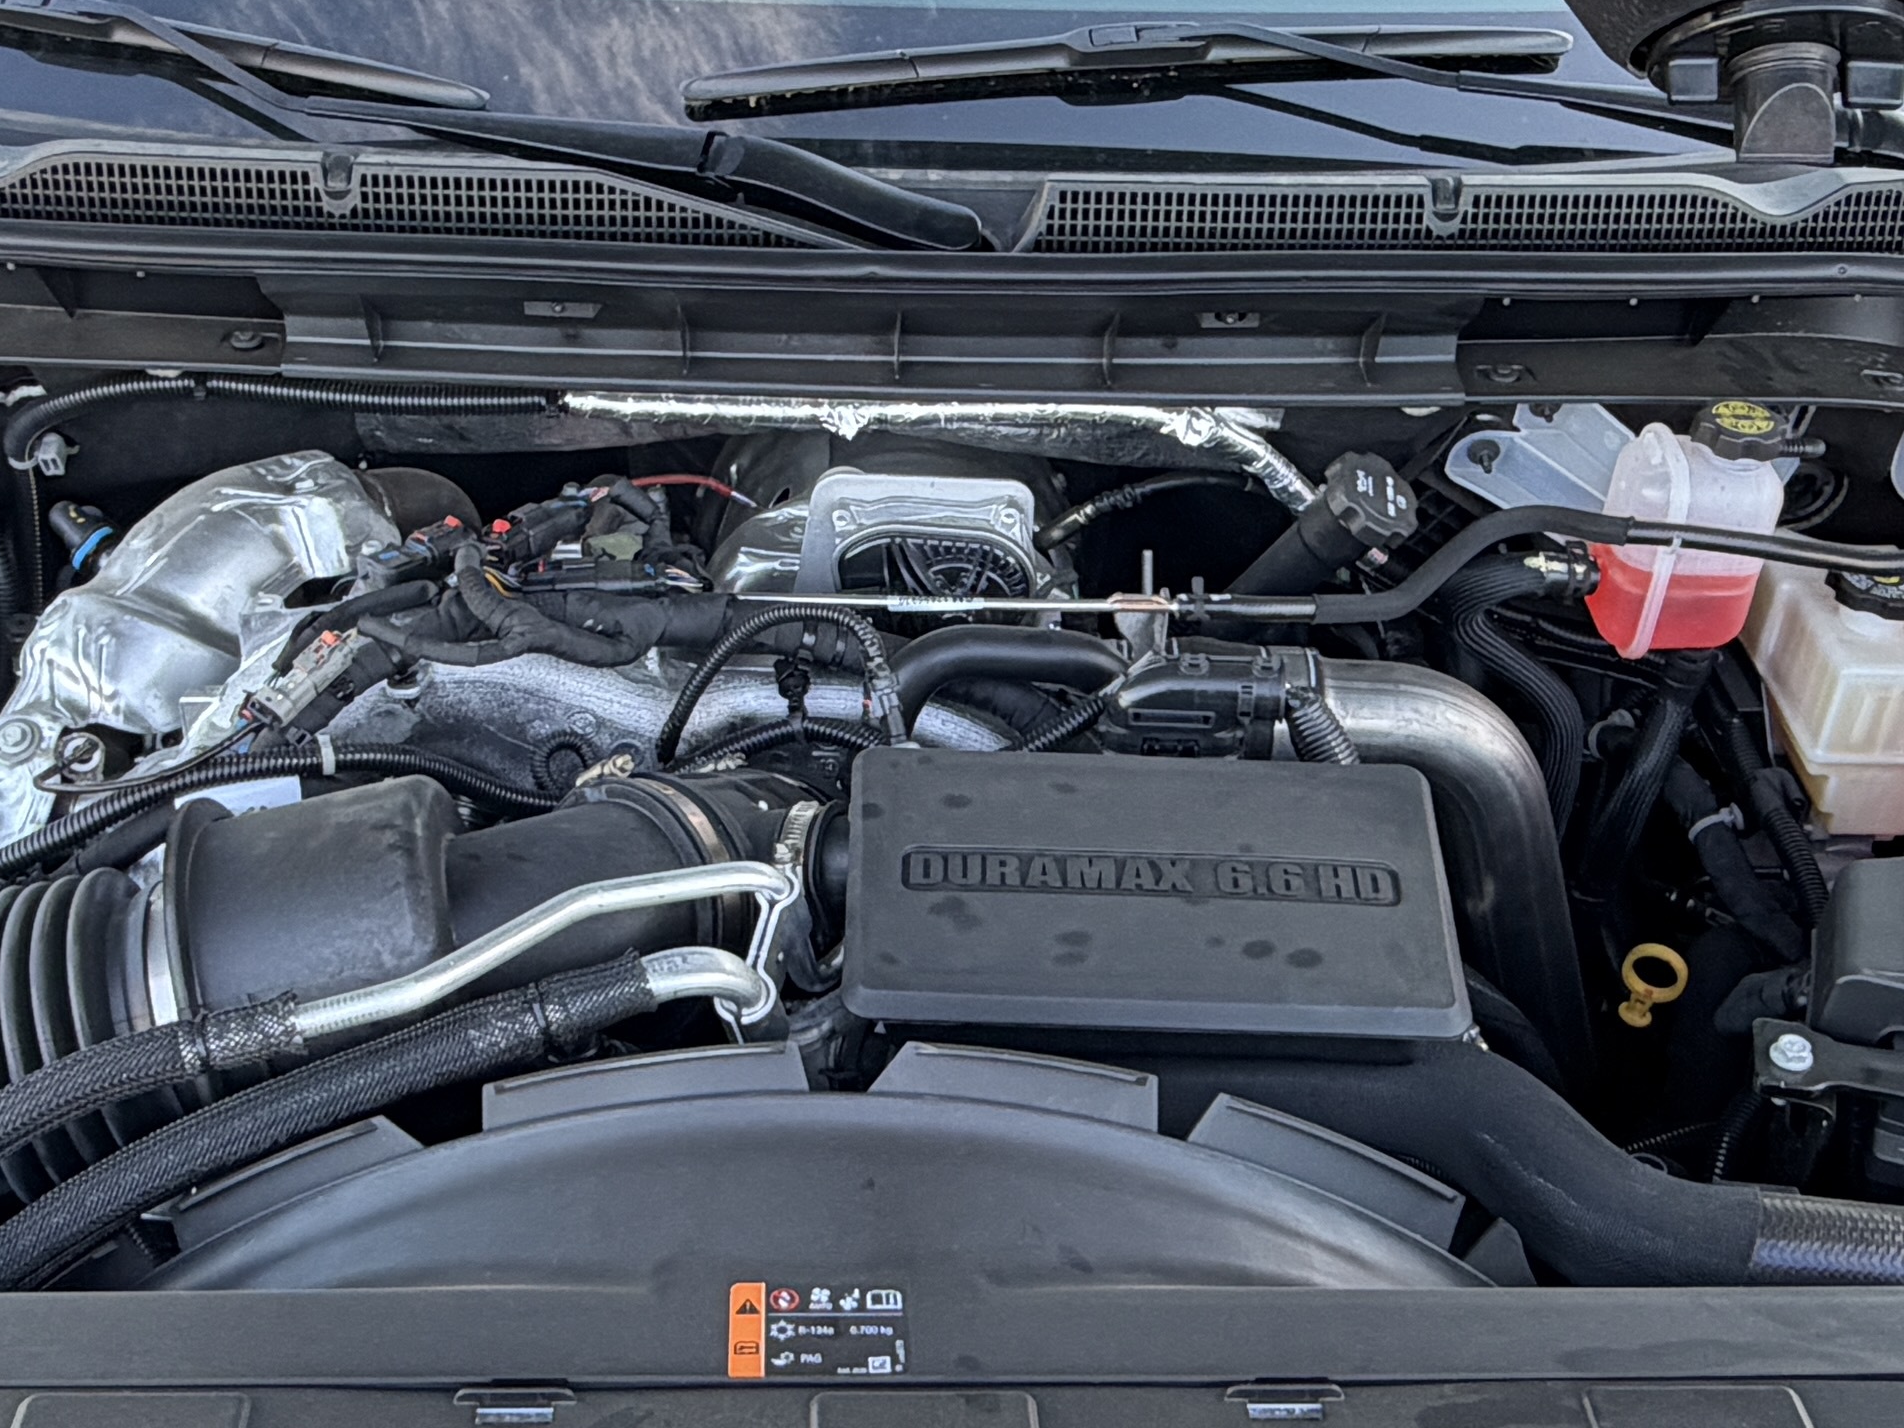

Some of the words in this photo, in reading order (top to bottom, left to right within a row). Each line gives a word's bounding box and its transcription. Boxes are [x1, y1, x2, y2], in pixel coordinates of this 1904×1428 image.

[908, 852, 1193, 894] DURAMAX
[1216, 860, 1305, 897] 6.6
[1318, 864, 1394, 904] HD
